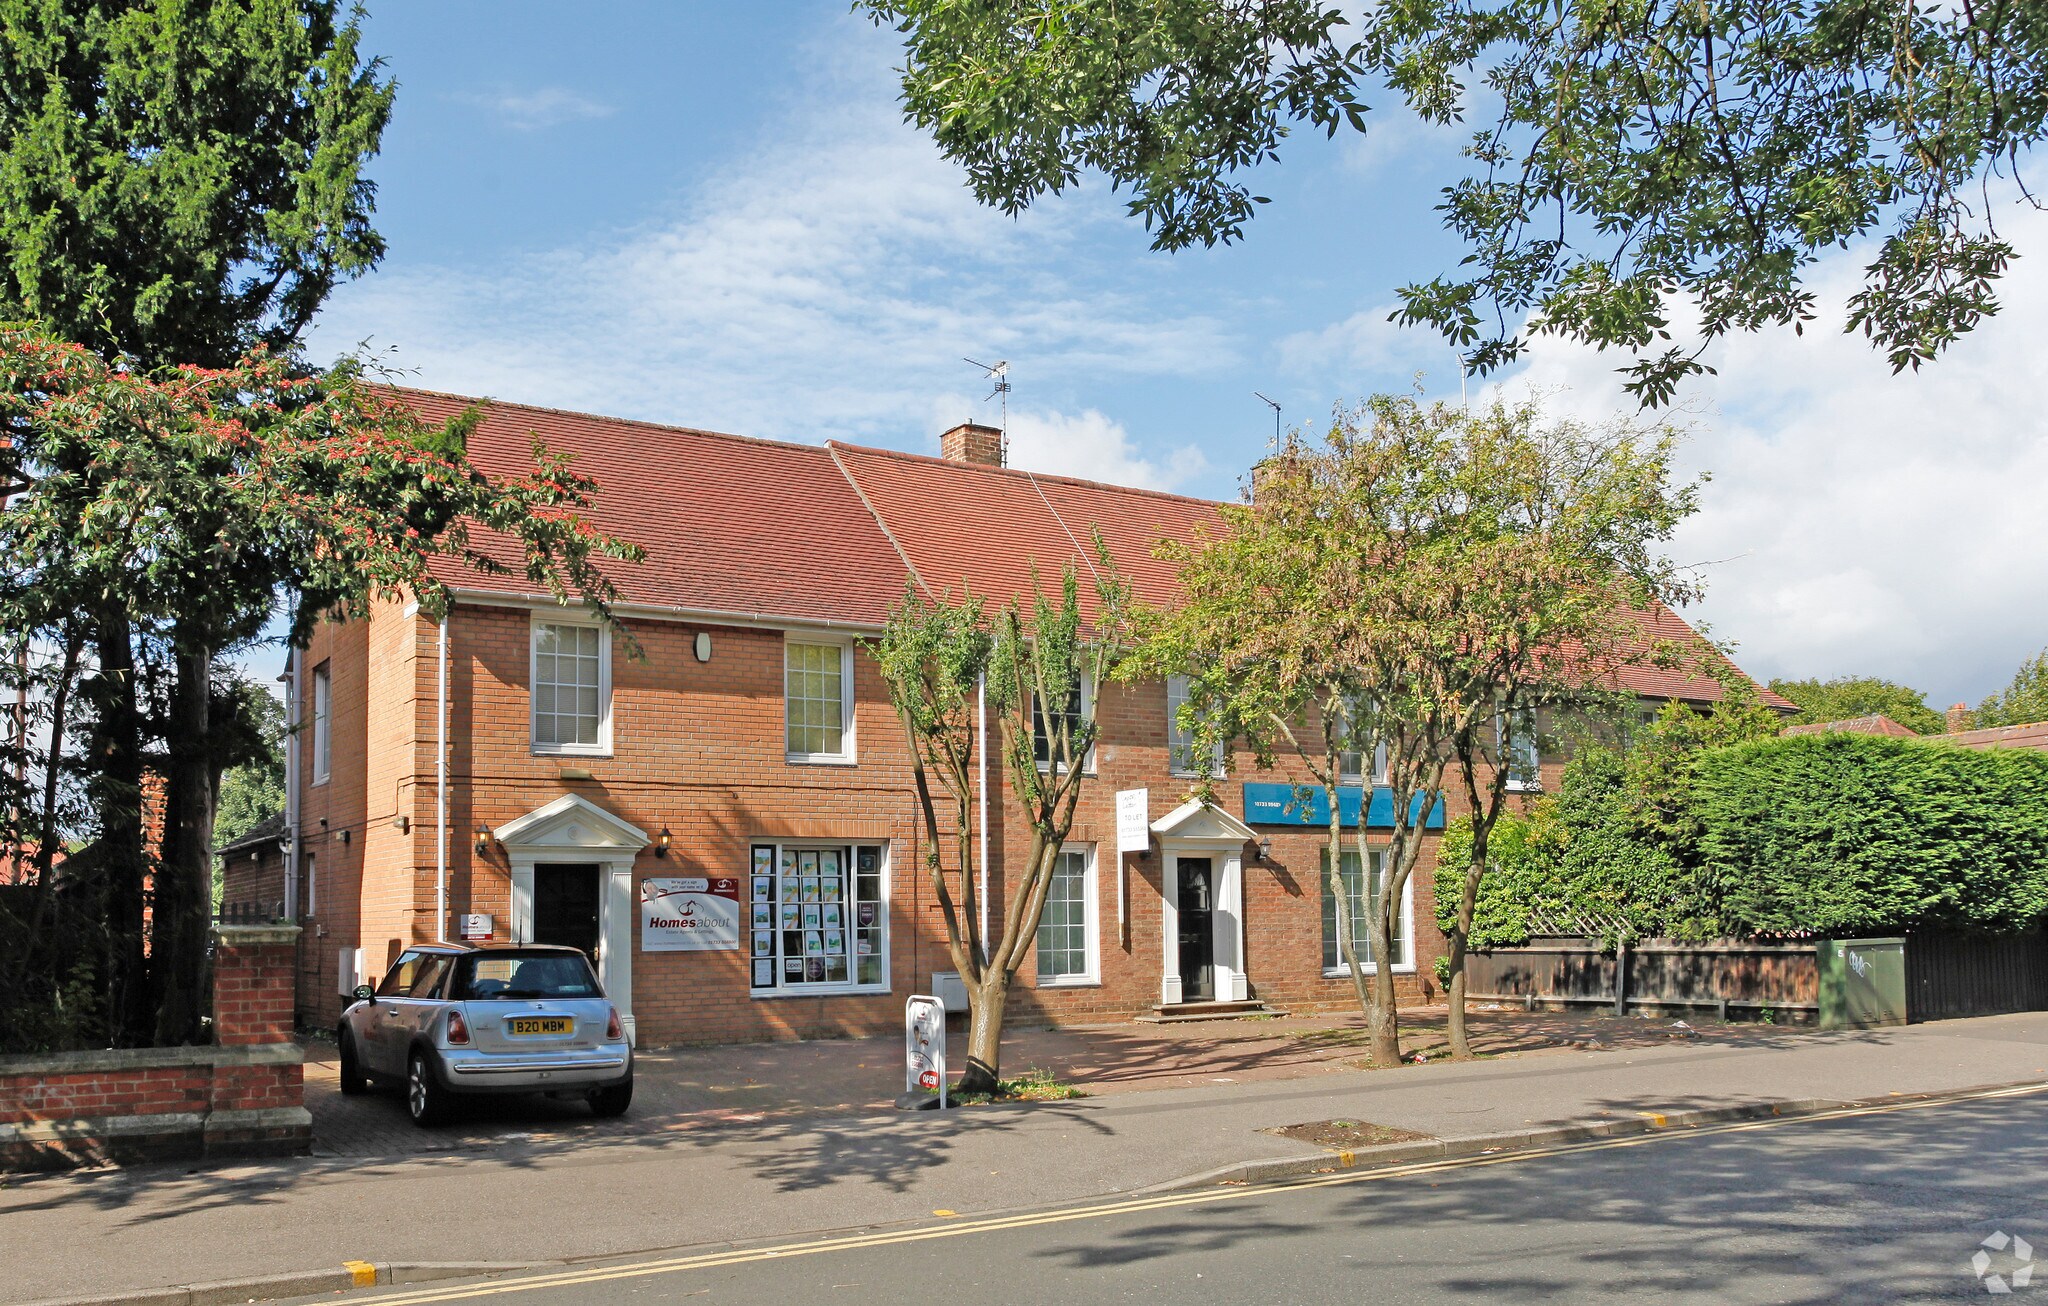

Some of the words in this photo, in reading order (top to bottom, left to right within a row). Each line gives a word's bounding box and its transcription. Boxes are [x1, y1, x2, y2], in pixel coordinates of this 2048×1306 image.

[649, 917, 730, 928] Homesabout
[517, 1021, 539, 1033] B20
[542, 1020, 565, 1032] MBM
[922, 1074, 937, 1085] OPEN
